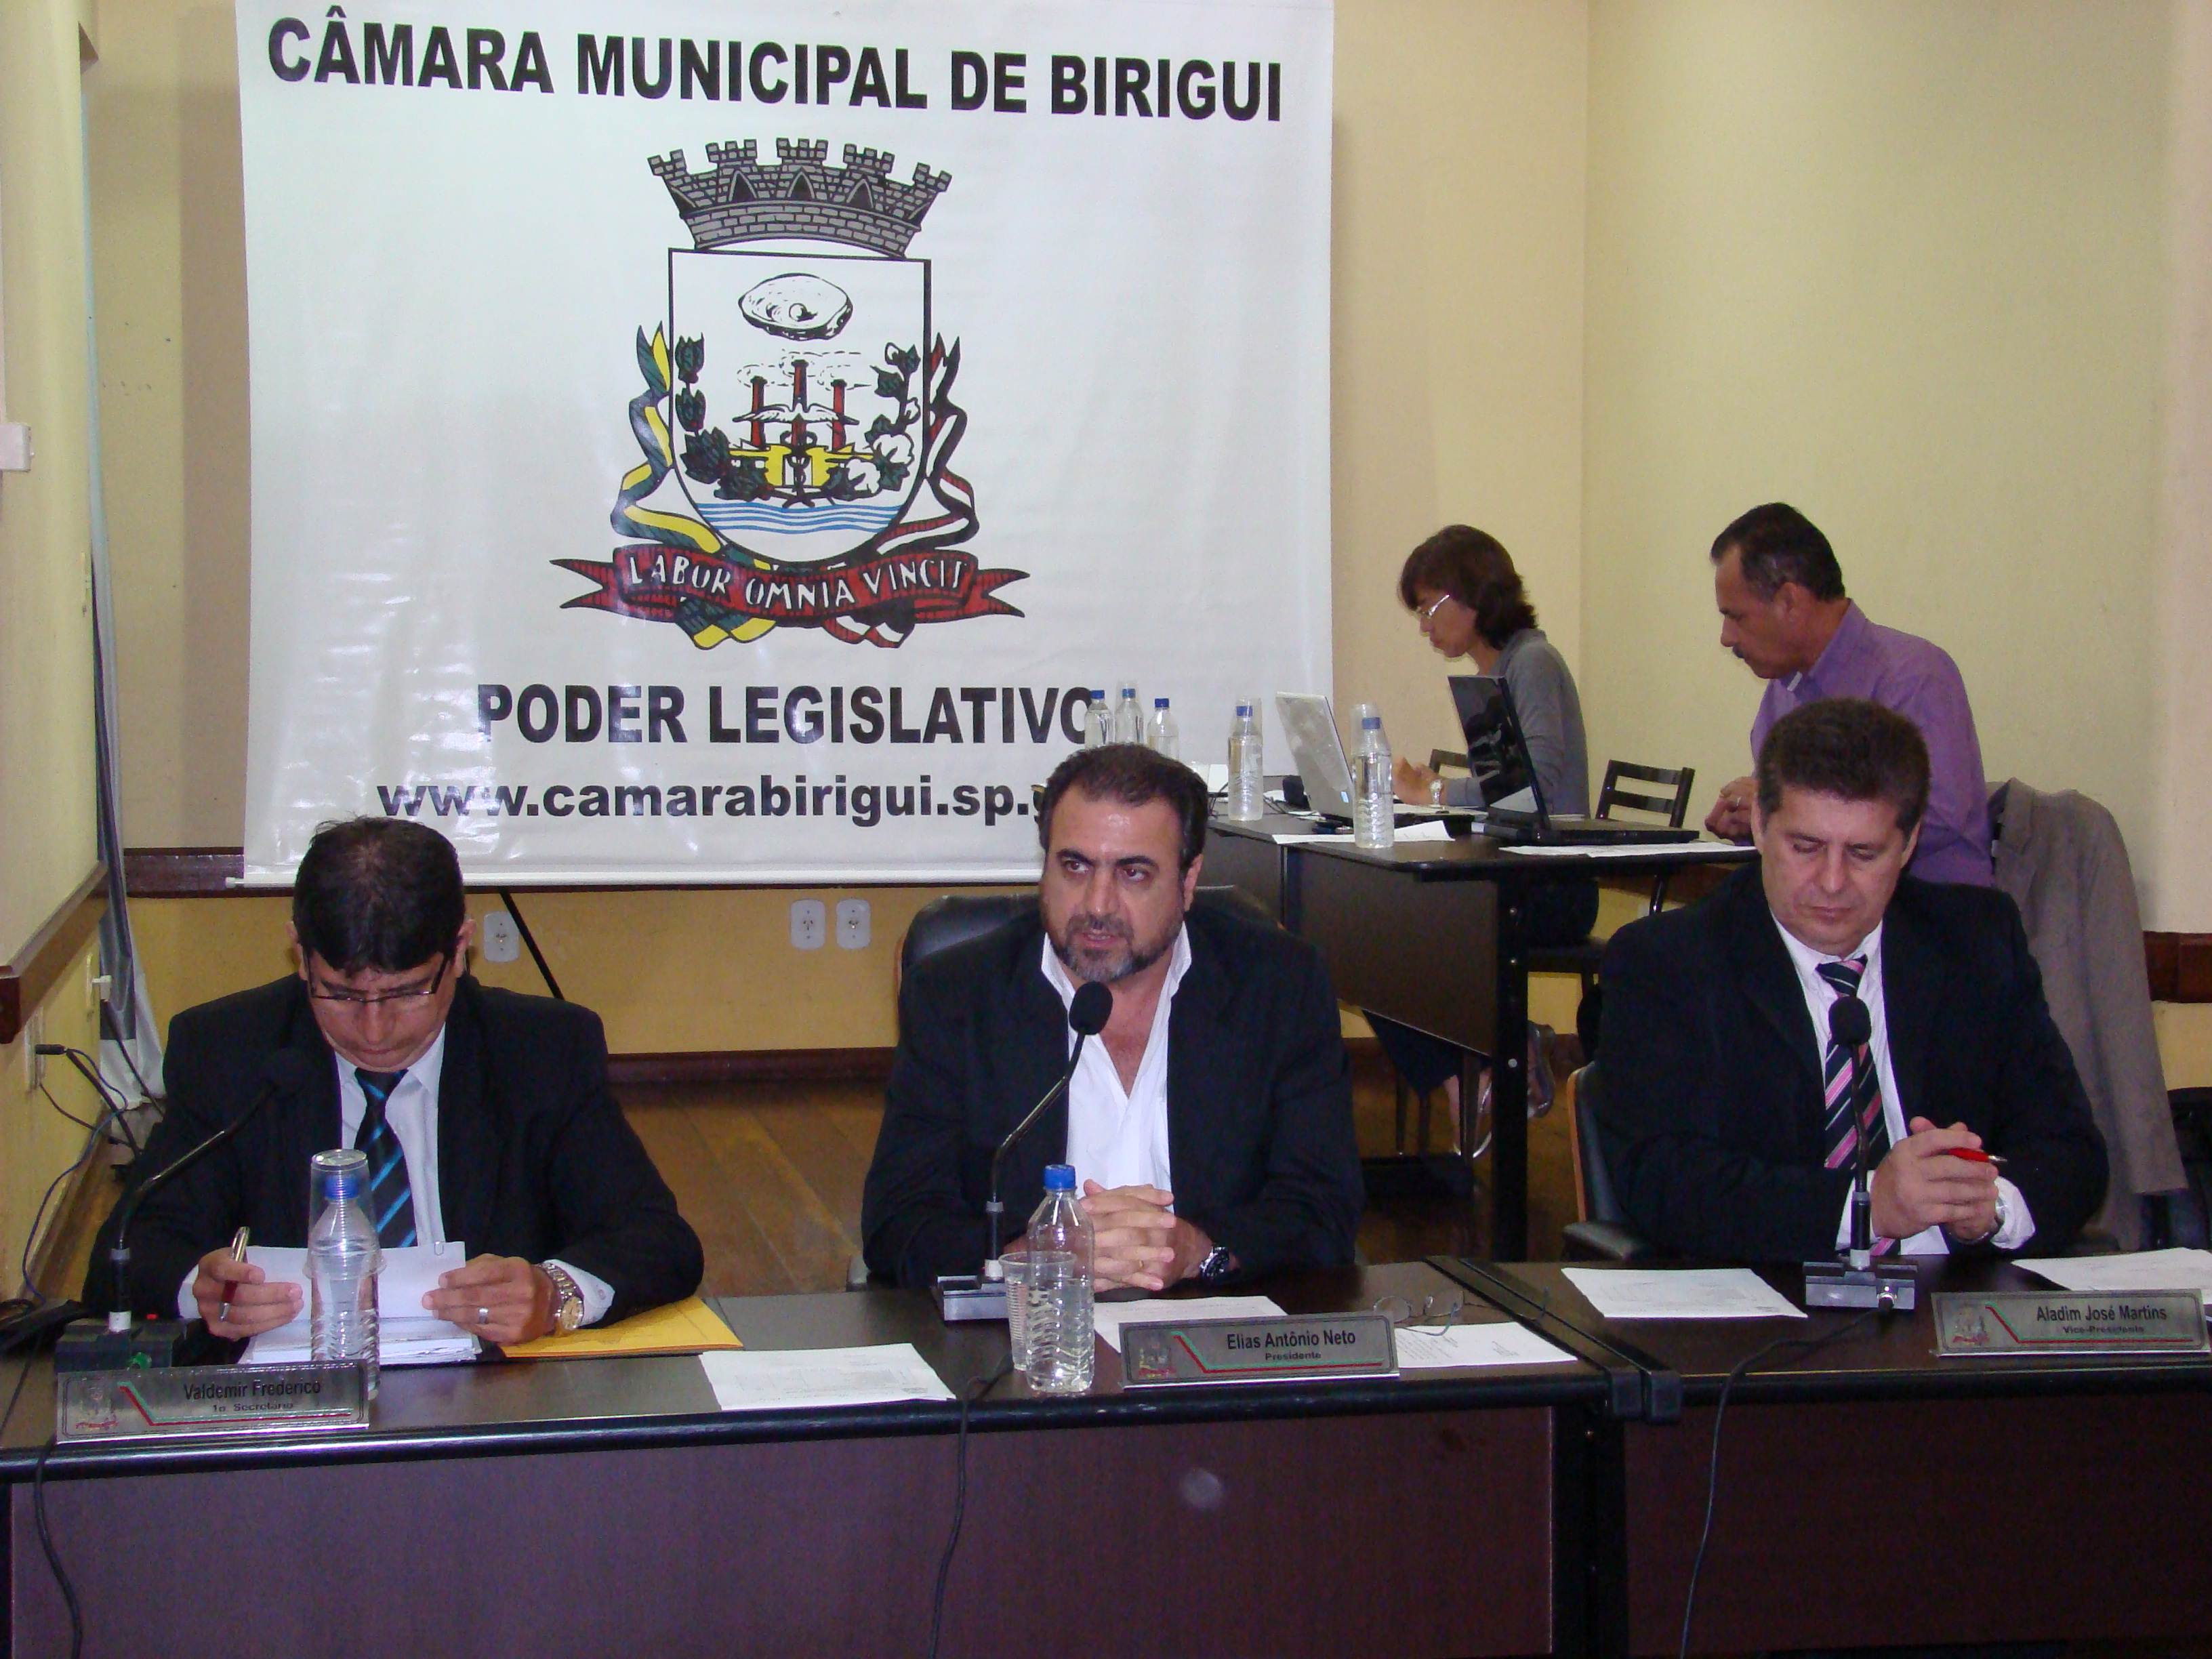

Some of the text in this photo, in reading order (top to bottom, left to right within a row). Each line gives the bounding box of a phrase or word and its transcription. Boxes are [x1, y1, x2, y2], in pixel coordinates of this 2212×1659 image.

[268, 5, 1281, 121] CÂMARA MUNICIPAL DE BIRIGUI
[745, 576, 857, 609] OMNIA
[477, 683, 1092, 745] PODER LEGISLATIVO
[377, 775, 1042, 827] www.camarabirigui.sp.
[2036, 1305, 2168, 1322] Aladim José Martins
[1227, 1329, 1355, 1350] Elias Antônio Neto
[1265, 1352, 1322, 1361] Presidente
[184, 1378, 321, 1400] Valdemir Frederico
